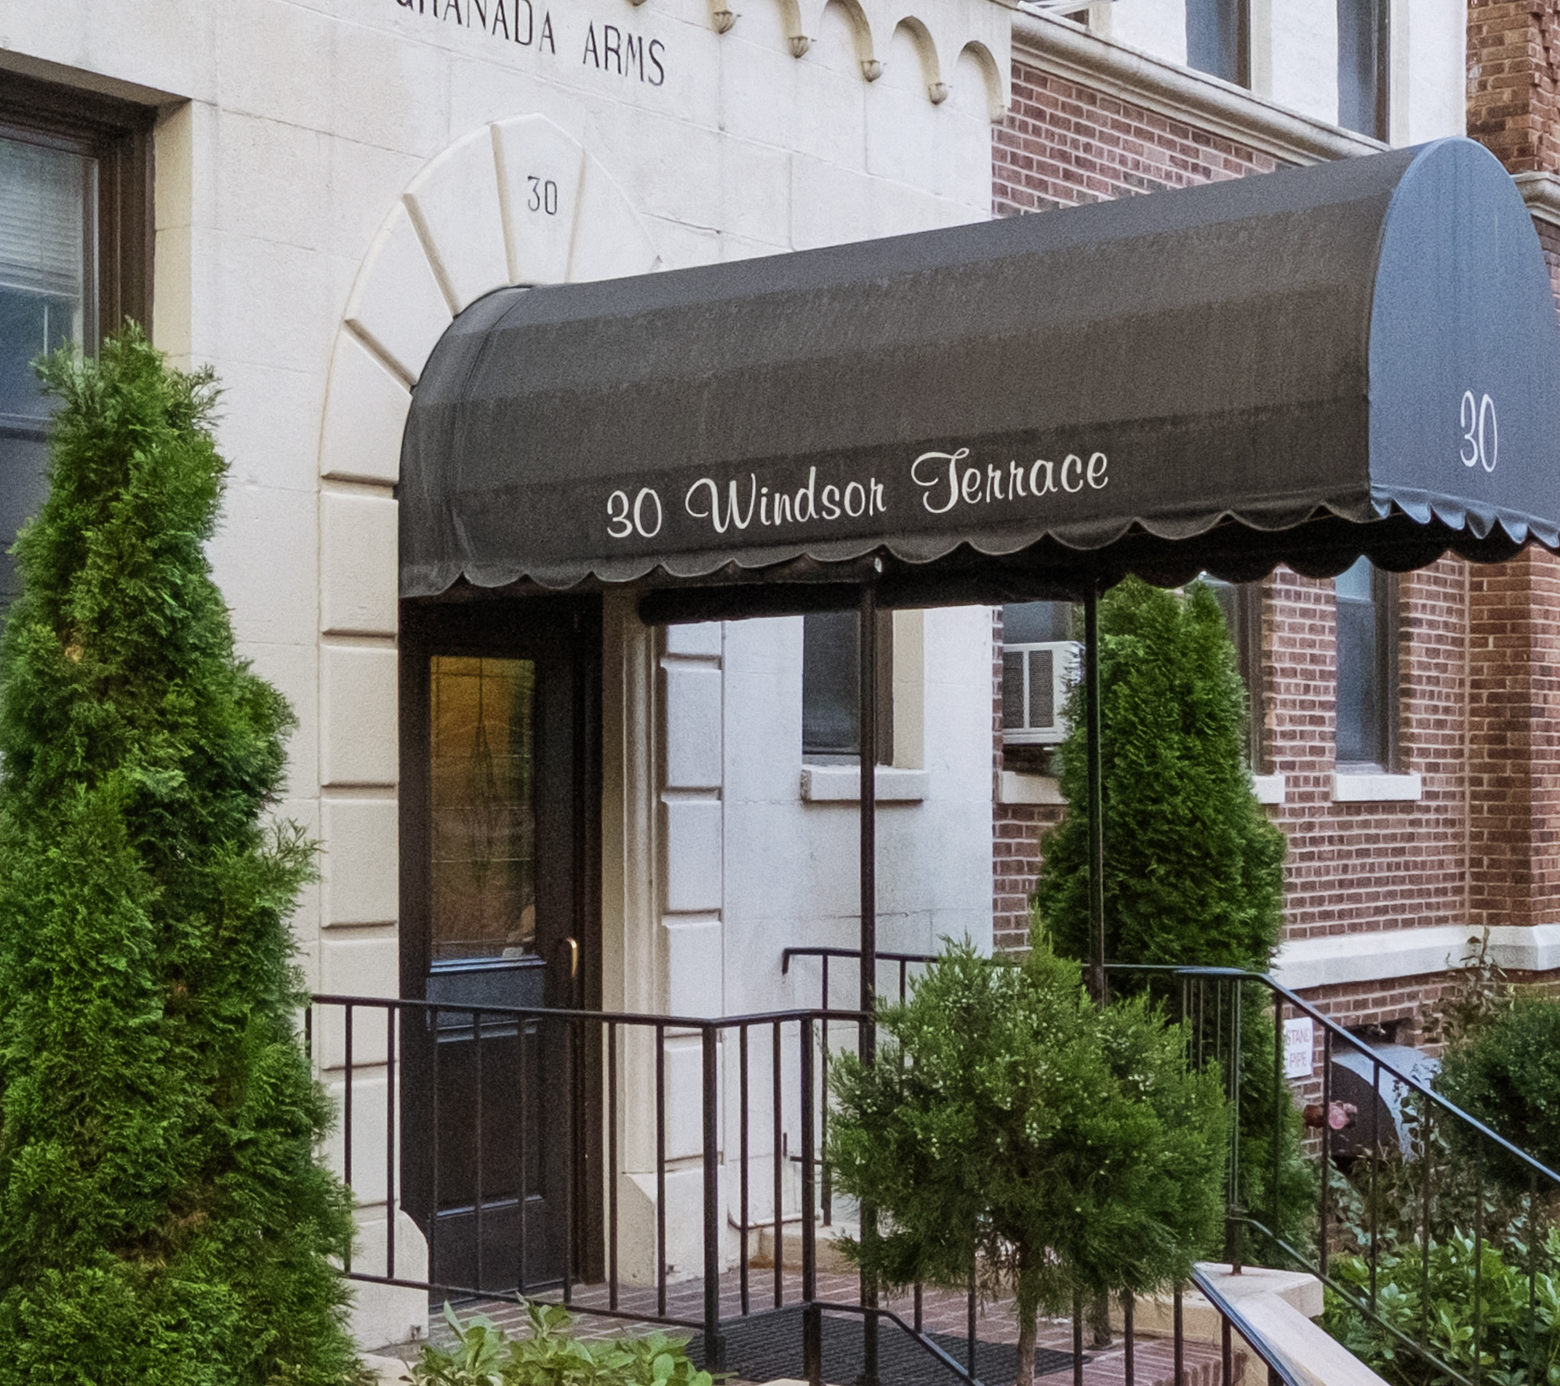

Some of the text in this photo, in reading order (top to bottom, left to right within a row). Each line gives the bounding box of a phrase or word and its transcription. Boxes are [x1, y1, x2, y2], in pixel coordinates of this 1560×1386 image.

[582, 19, 665, 86] ARMS
[527, 175, 558, 215] 30
[1459, 389, 1498, 473] 30
[606, 447, 1109, 538] 30 Windsor Terrace
[1285, 1027, 1311, 1046] STAND
[1290, 1050, 1307, 1068] PIPE
